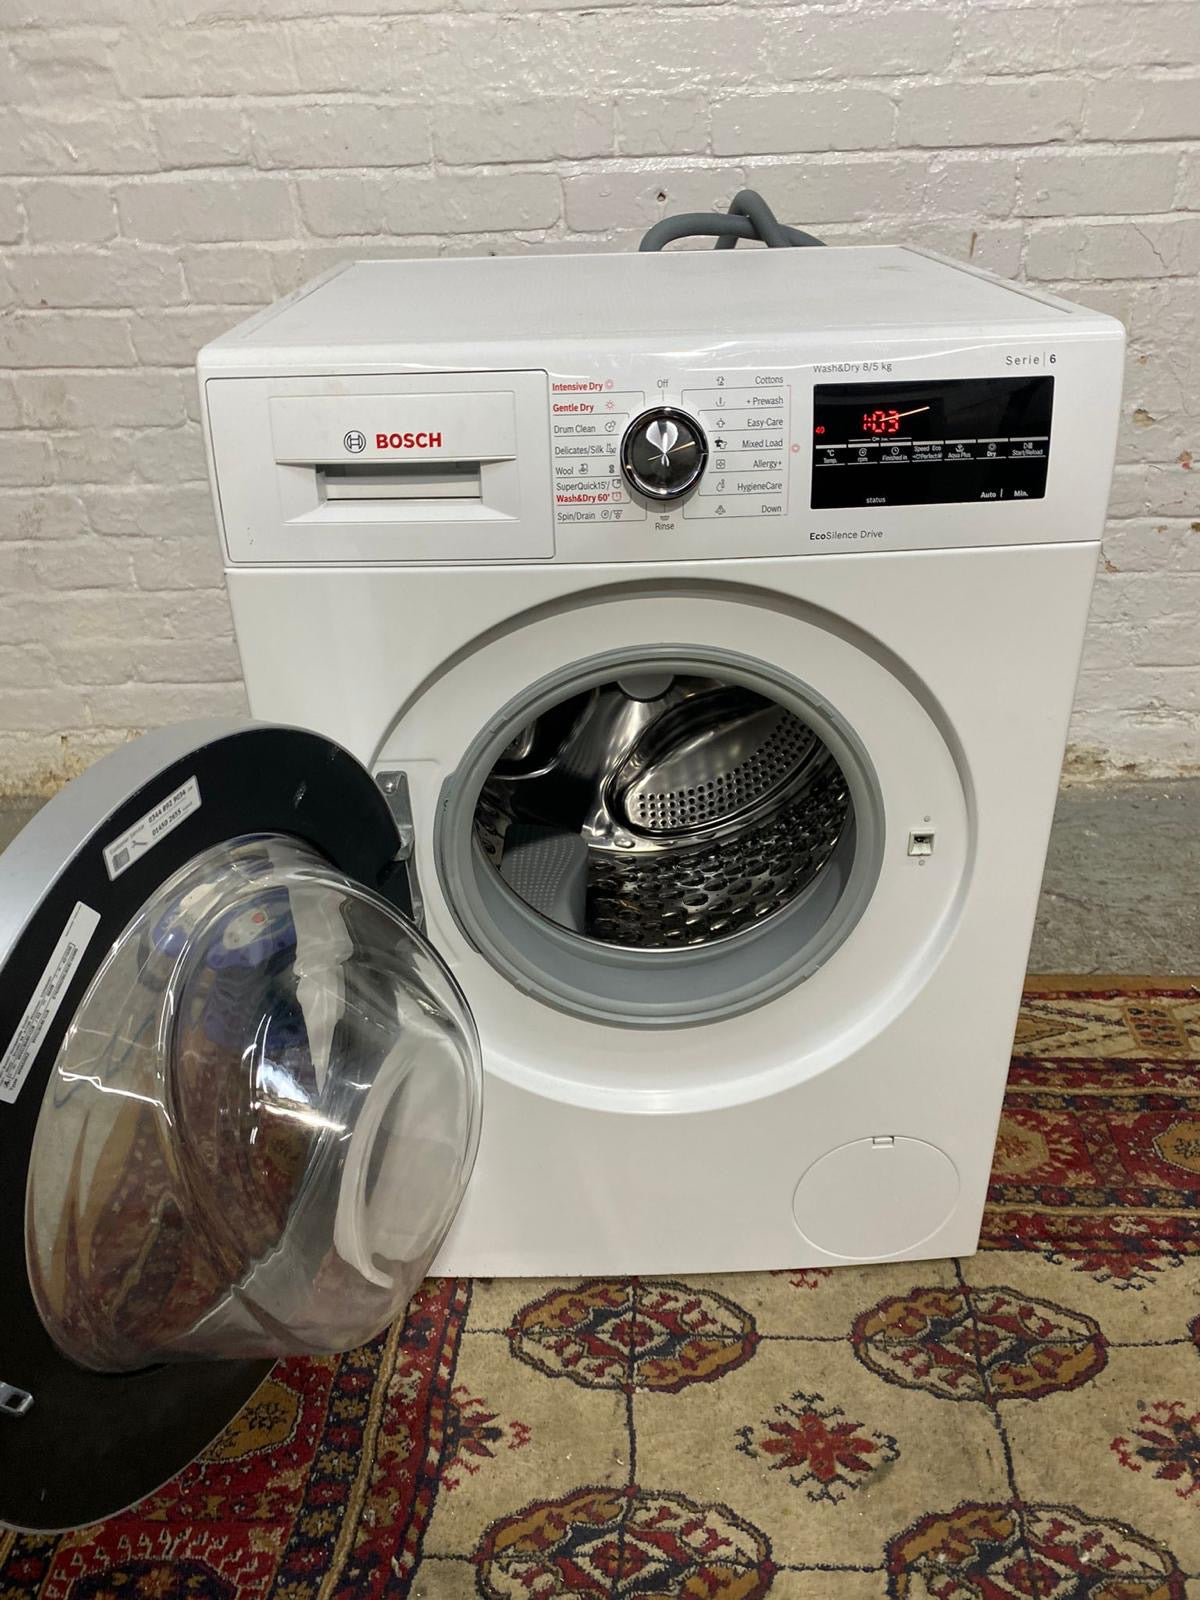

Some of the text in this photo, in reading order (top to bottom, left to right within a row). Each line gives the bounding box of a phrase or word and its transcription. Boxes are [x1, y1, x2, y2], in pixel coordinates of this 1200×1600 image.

[1005, 354, 1057, 366] Serie 6
[813, 361, 893, 373] Wash&Dry 8/5 kg
[656, 379, 670, 389] Off
[754, 375, 784, 385] Cottons
[552, 382, 604, 392] Intensive Dry
[752, 396, 784, 405] Prewash
[552, 403, 594, 413] Gentle Dry
[553, 424, 596, 434] Drum Clean
[376, 432, 442, 449] BOSCH
[742, 438, 783, 448] Mixed Load
[554, 445, 604, 455] Delicates/Silk
[986, 449, 997, 458] Dry
[555, 466, 574, 475] Wool
[737, 481, 782, 492] HygieneCare
[556, 493, 597, 503] Wash&Dry
[980, 489, 1029, 499] Auto Min.
[865, 496, 886, 504] status
[761, 504, 782, 514] Down
[557, 511, 596, 521] Spin/Drain
[655, 522, 674, 532] Rinse
[809, 529, 884, 541] EcoSilence Drive
